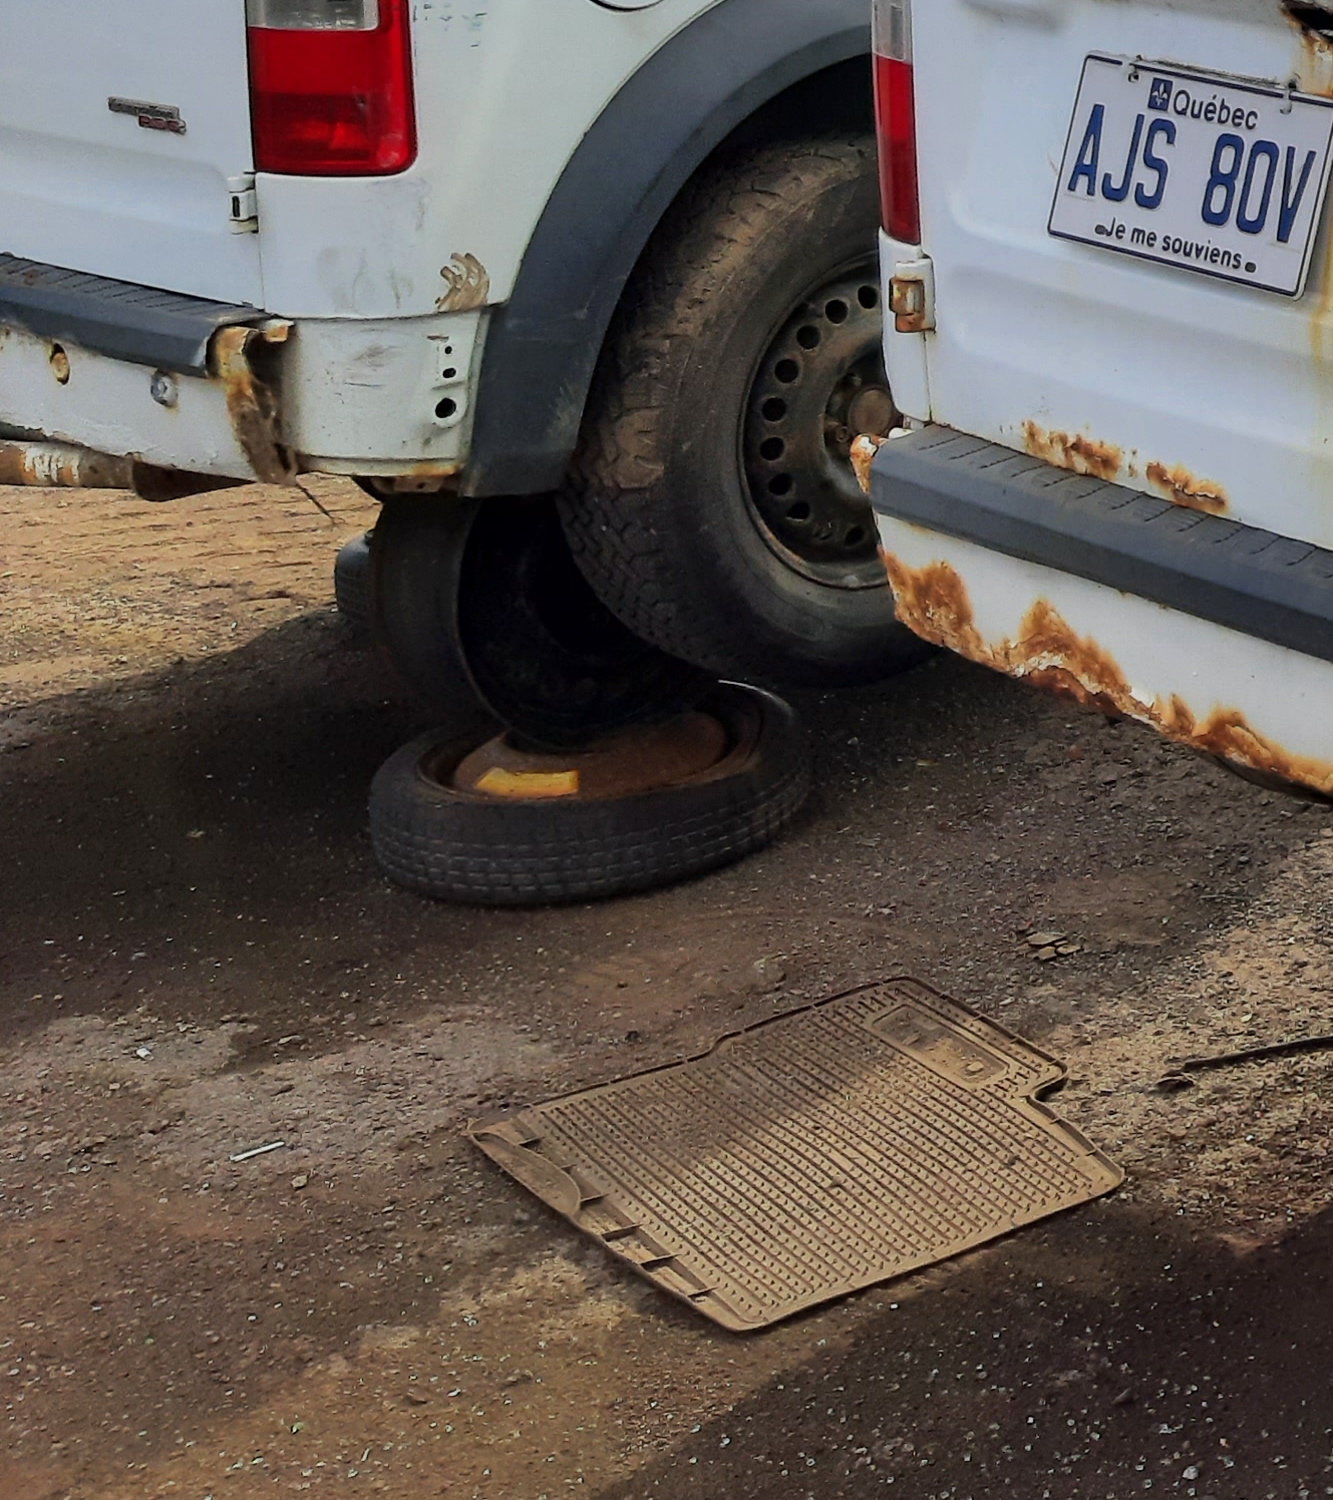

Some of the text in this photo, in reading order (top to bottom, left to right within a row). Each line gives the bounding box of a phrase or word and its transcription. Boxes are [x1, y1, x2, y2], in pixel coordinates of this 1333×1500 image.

[1172, 88, 1259, 131] Québec
[1067, 103, 1177, 210] AJS
[1104, 216, 1243, 271] Je me souviens
